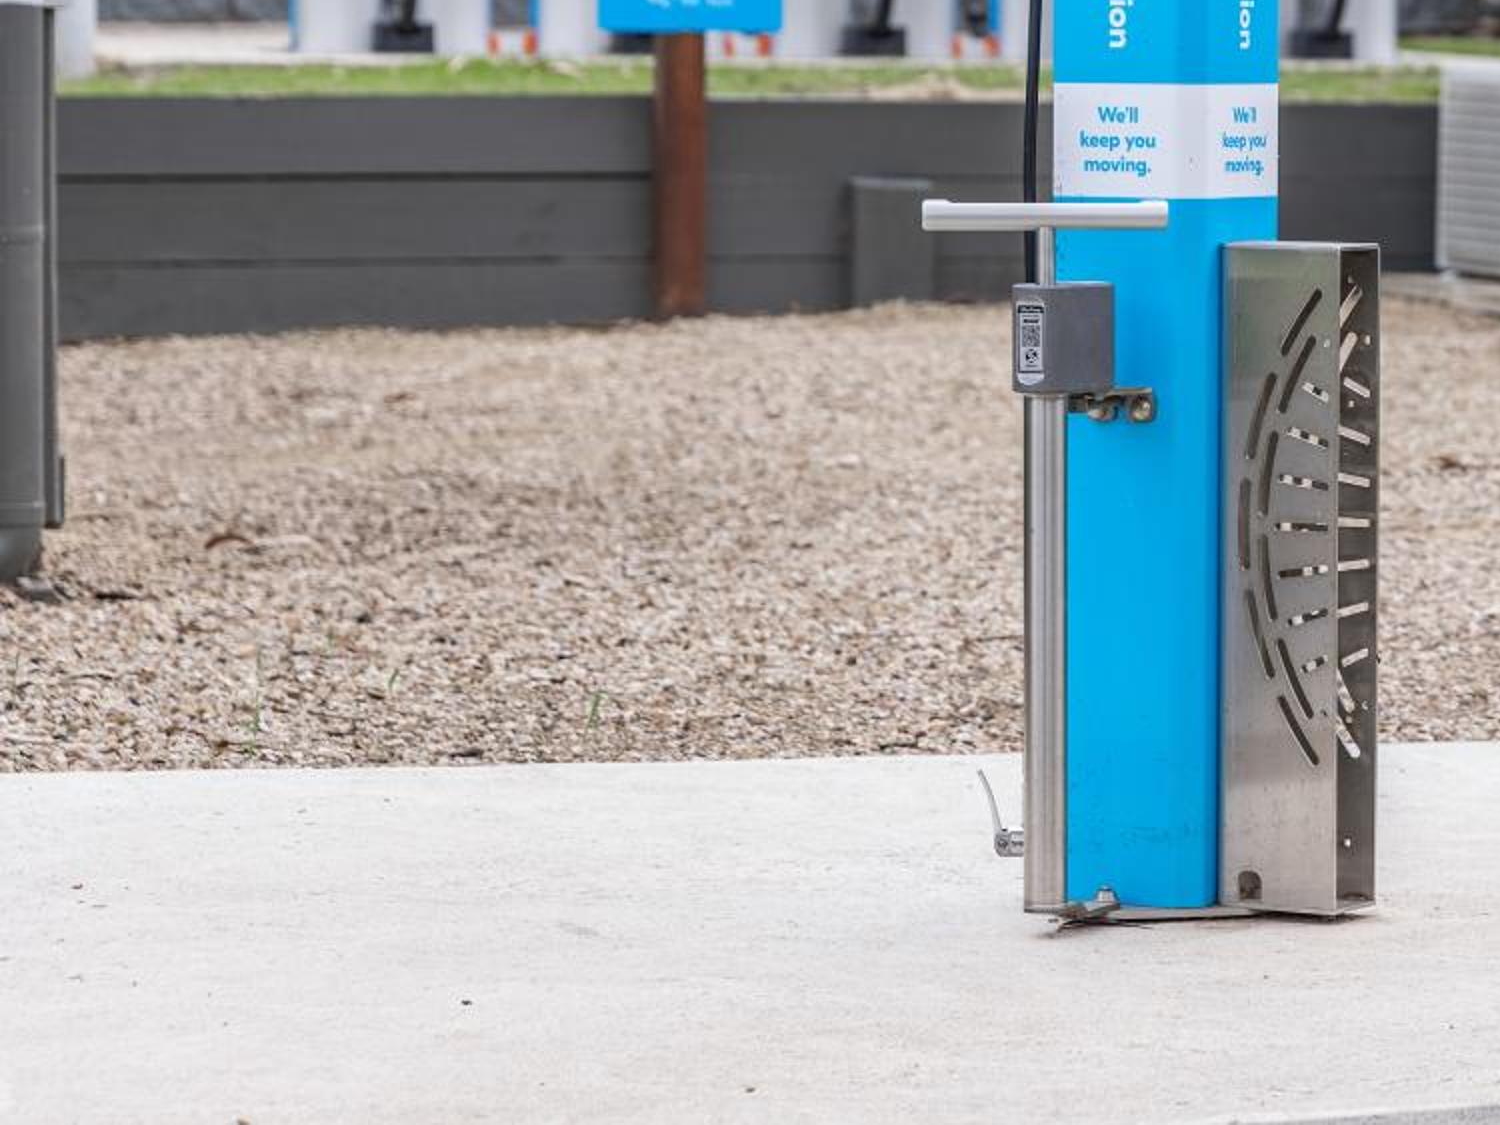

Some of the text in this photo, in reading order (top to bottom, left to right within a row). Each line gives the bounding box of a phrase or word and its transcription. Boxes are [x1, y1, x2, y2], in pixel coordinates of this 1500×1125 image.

[1098, 106, 1139, 124] We'll
[1080, 131, 1156, 153] keep you
[1223, 132, 1267, 153] keep you
[1084, 156, 1152, 177] moving.
[1225, 156, 1265, 177] moving.
